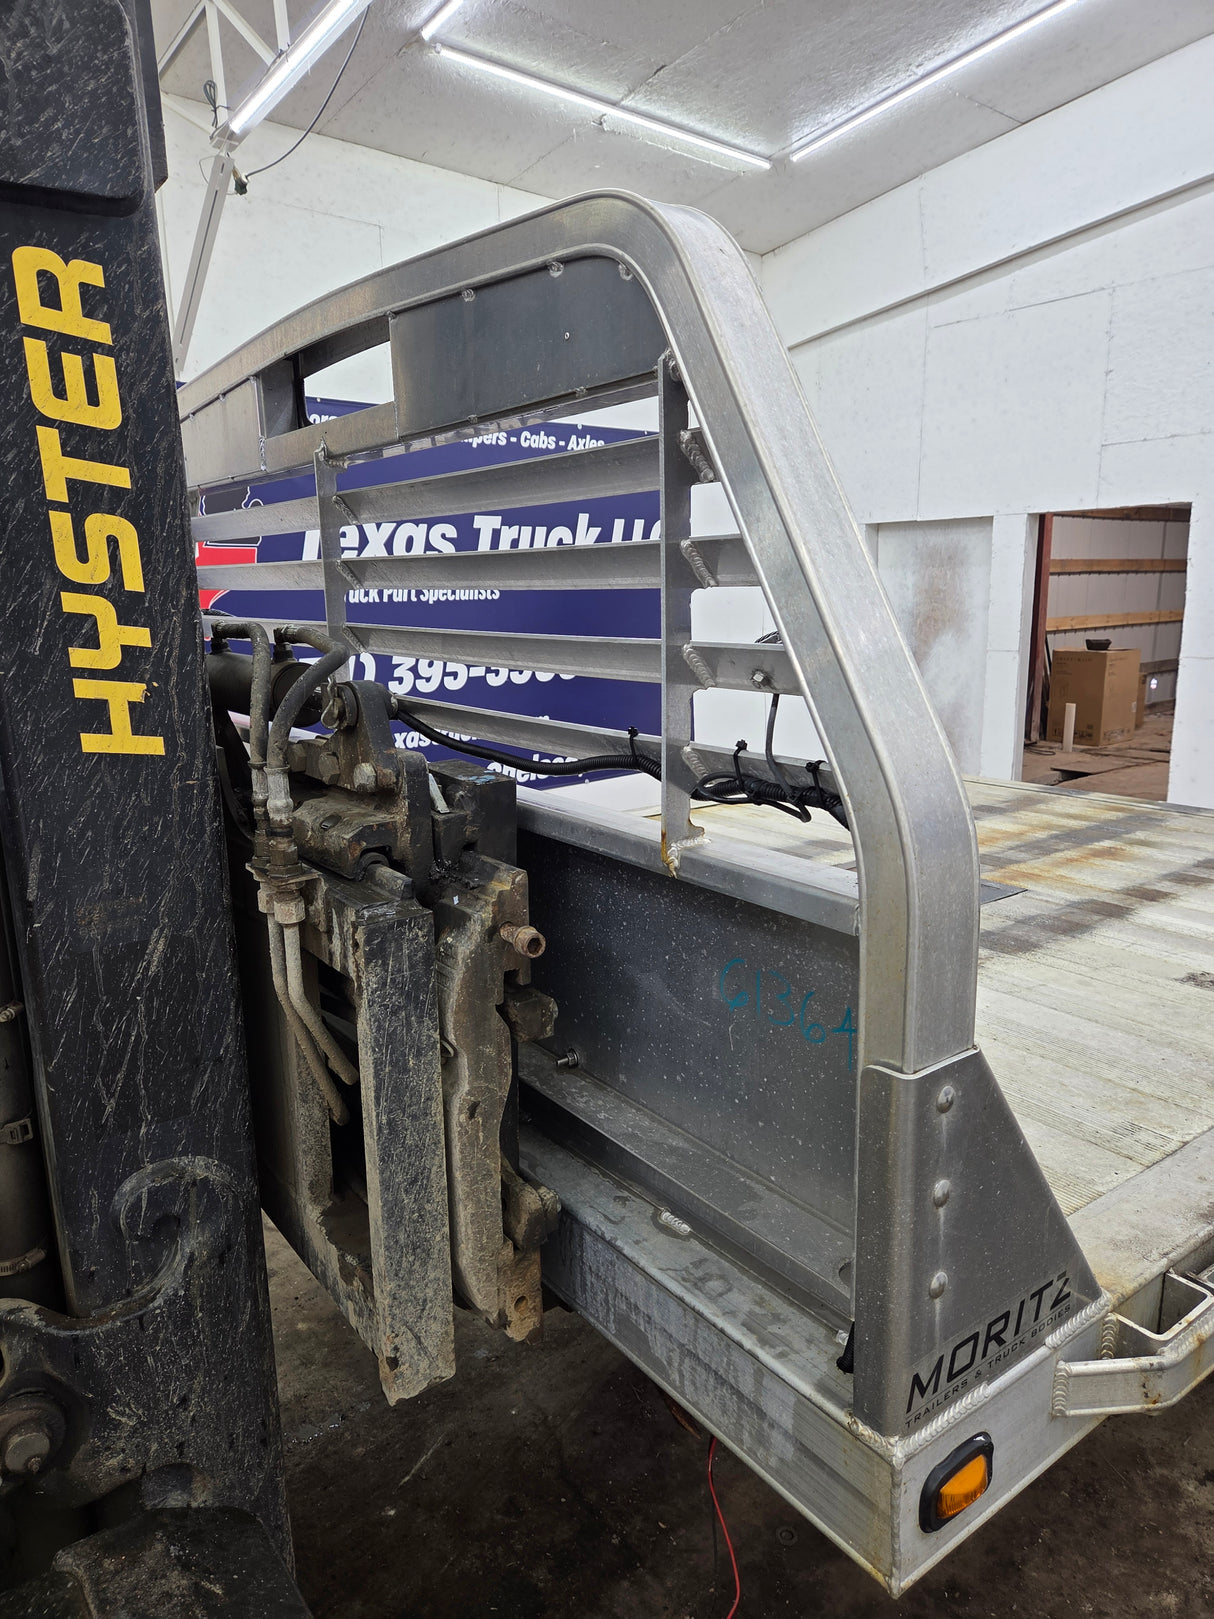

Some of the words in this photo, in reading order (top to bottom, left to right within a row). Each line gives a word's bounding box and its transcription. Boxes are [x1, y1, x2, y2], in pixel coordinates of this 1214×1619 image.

[11, 245, 166, 756] HYSTER
[520, 431, 557, 450] Cabs
[473, 513, 602, 551] Truck
[904, 1378, 968, 1429] TRAILERS
[974, 1369, 982, 1380] &
[986, 1336, 1026, 1369] TRUCK
[1031, 1303, 1071, 1338] BODIES
[906, 1270, 1072, 1415] MORITZ
